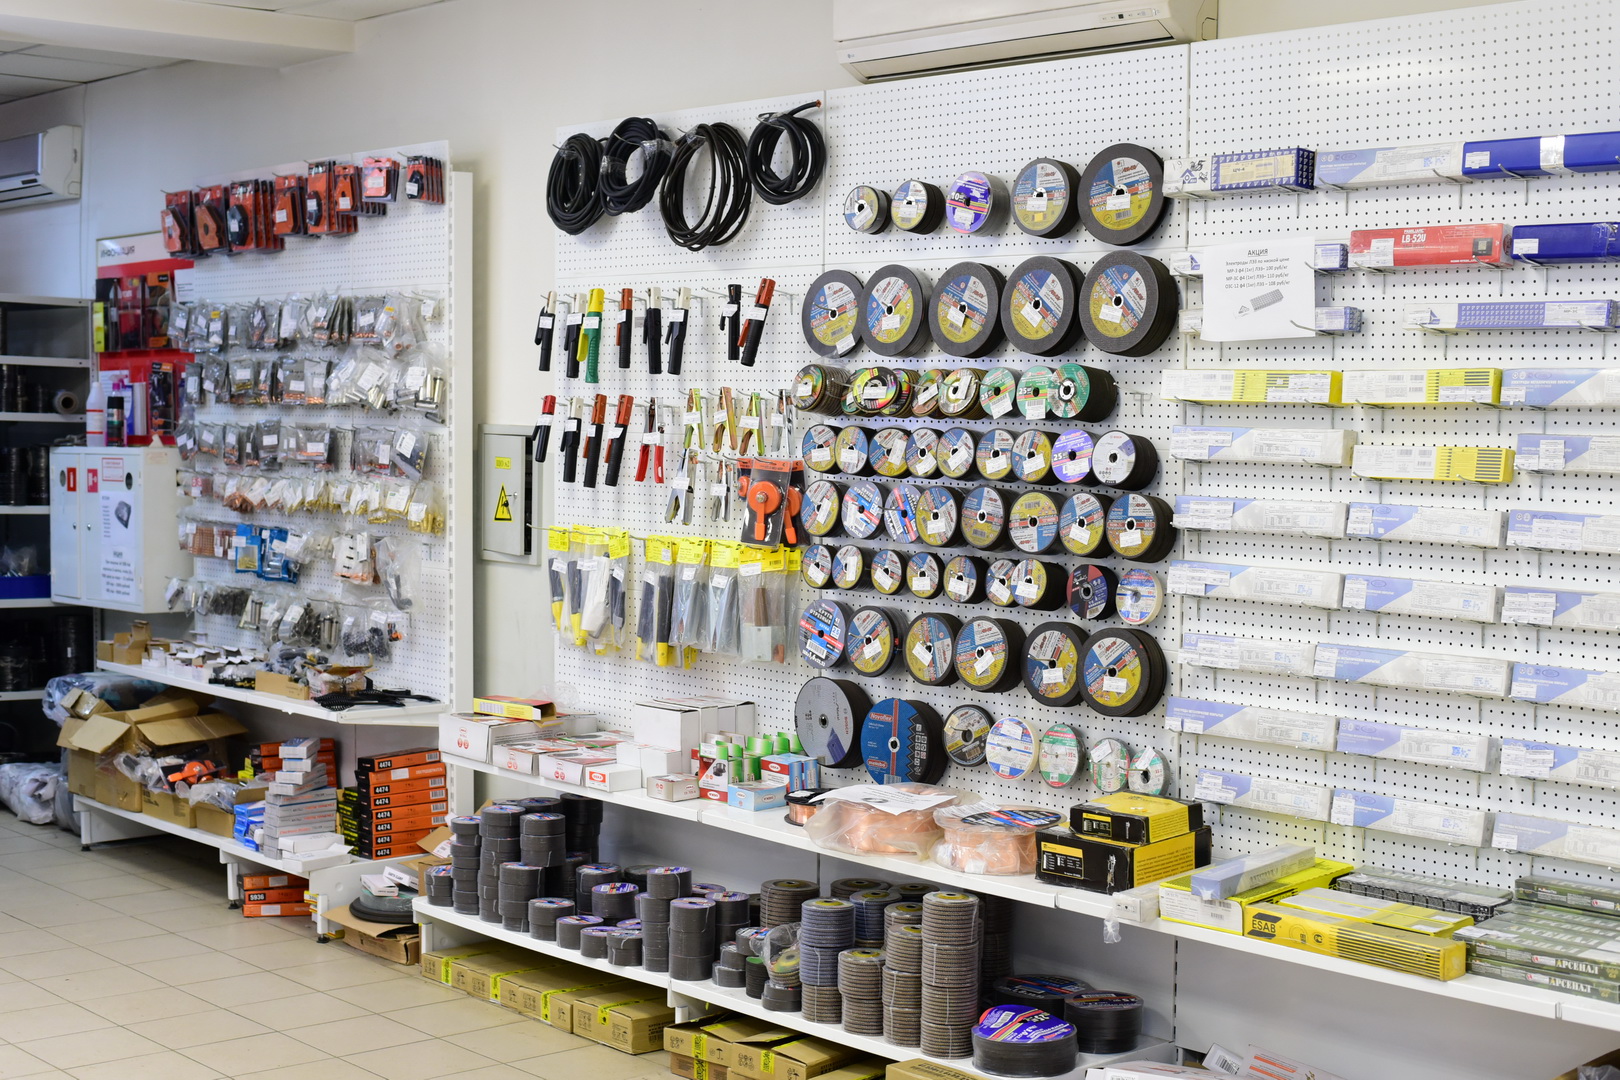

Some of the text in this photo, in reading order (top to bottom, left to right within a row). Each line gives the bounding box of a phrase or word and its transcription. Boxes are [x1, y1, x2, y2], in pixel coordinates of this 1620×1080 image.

[1402, 233, 1426, 243] LB-52U
[981, 392, 989, 400] 25
[870, 713, 892, 721] Novoflex
[1251, 920, 1276, 934] ESAB
[1556, 959, 1599, 975] АРСЕНАЛ
[1550, 977, 1592, 993] АРСЕНАЛ
